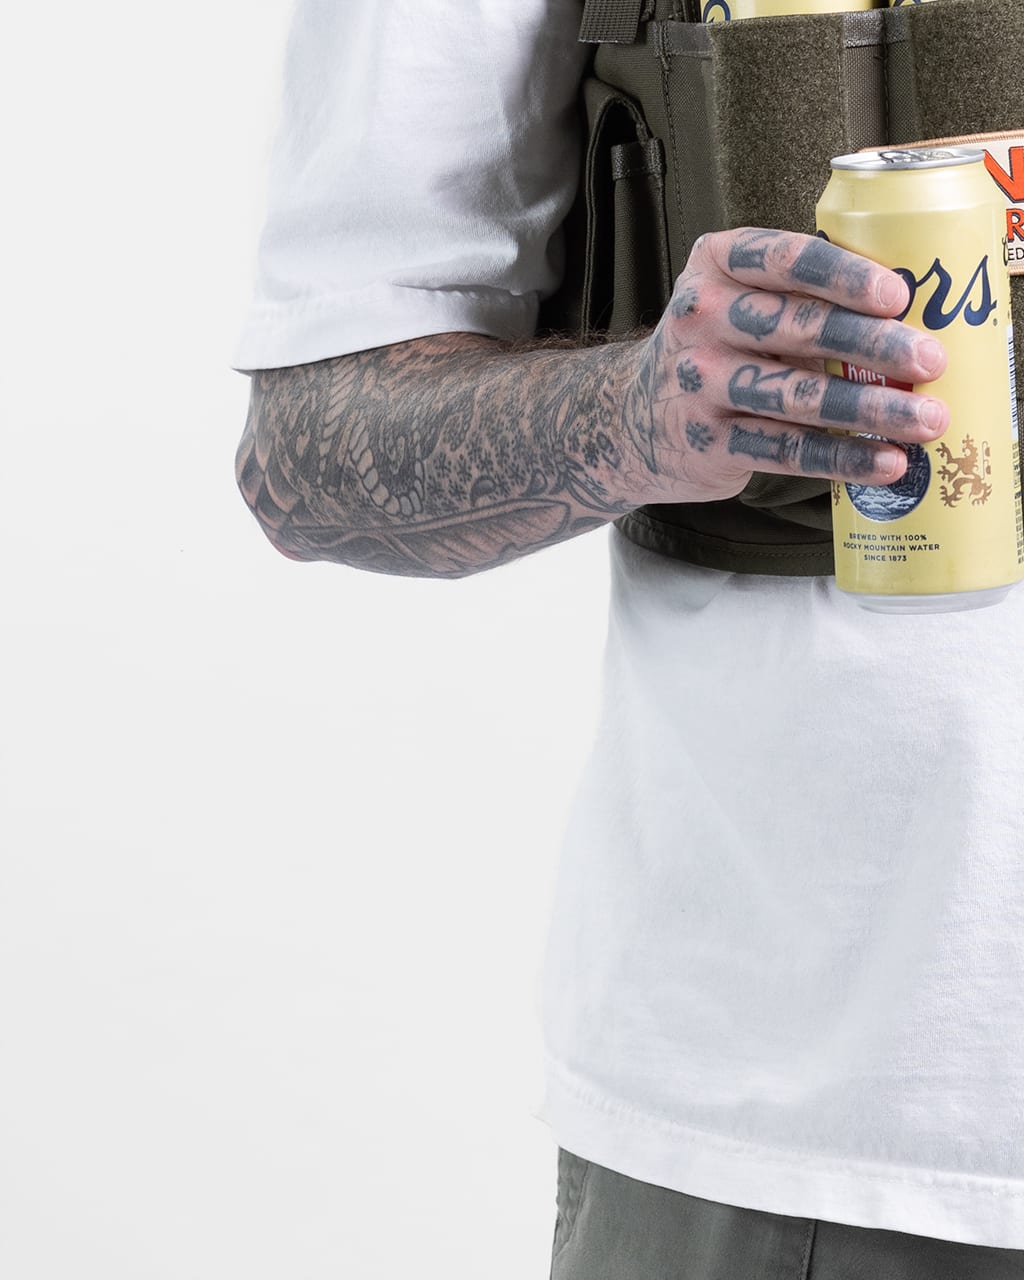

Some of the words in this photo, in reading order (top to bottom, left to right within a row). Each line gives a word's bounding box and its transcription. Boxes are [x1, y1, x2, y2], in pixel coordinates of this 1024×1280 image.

[849, 532, 877, 540] BREWED
[843, 541, 862, 549] ROCKY
[908, 543, 940, 551] WATER
[863, 554, 886, 562] SINCE
[888, 554, 908, 562] 1873
